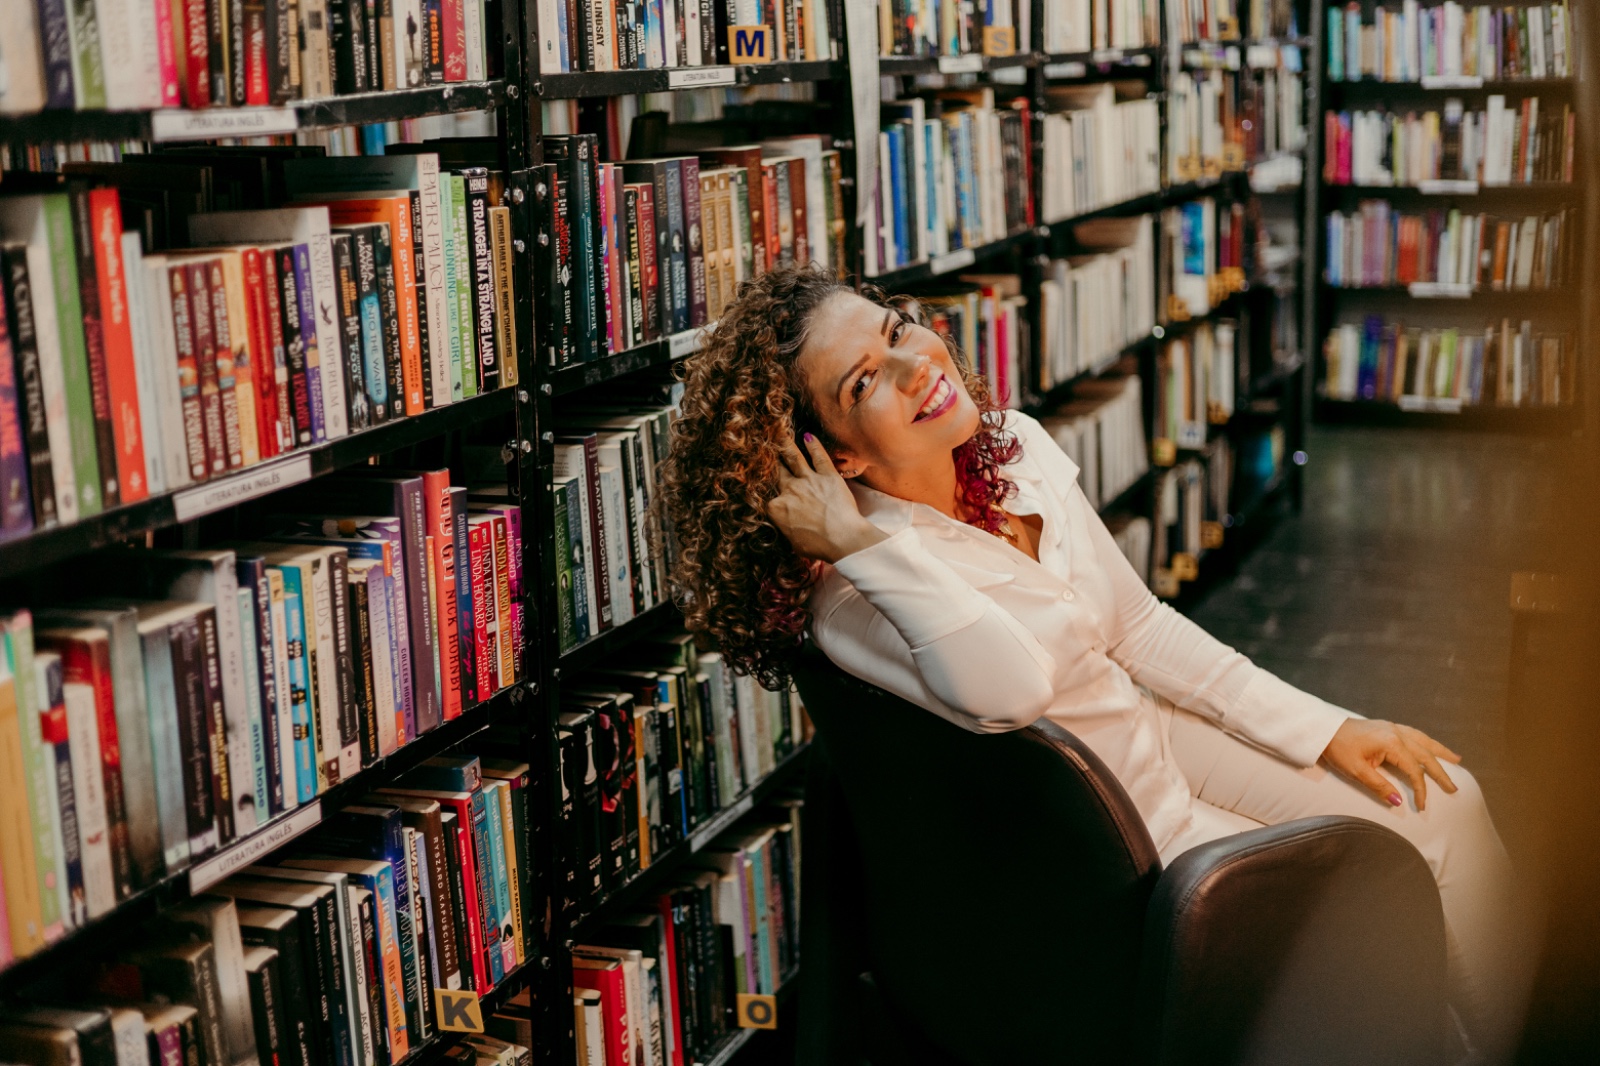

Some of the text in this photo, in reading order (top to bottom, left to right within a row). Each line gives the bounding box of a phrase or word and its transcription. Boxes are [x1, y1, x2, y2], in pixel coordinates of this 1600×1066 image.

[278, 14, 289, 67] ISLAND
[430, 10, 440, 64] reckless
[594, 1, 604, 46] LINDSAY
[736, 30, 764, 57] M
[252, 30, 264, 94] WHISTLER
[352, 33, 362, 87] GRISHAM
[358, 44, 366, 76] JOHN
[236, 114, 264, 127] INGLÊS
[423, 160, 436, 170] the
[423, 172, 443, 295] PAPER PALACE
[458, 206, 469, 289] PEOPLE WE MEET
[630, 227, 638, 259] THE
[318, 233, 332, 290] ROBERT
[357, 235, 369, 292] HAWKINS
[365, 244, 374, 281] PAULA
[386, 265, 394, 287] THE
[397, 203, 416, 352] really good, actually
[445, 239, 456, 299] RUNNING
[472, 198, 494, 366] STRANGER IN A STRANGE LAND
[496, 213, 512, 358] ARTHUR HAILEY THE MONEYCHANGERS
[340, 270, 352, 317] HARRISON
[349, 282, 357, 300] KIM
[387, 290, 395, 316] GIRL
[606, 292, 610, 306] of
[380, 278, 395, 386] PAULA HAWKINS
[390, 319, 398, 335] ON
[451, 325, 458, 333] A
[460, 293, 472, 370] EMILY HENRY
[562, 290, 572, 362] SLEIGHT HAND
[606, 310, 612, 324] Pi
[324, 336, 339, 407] IMPERIUM
[350, 344, 359, 381] POOL
[367, 302, 377, 332] INTO
[373, 358, 382, 396] WATER
[451, 336, 461, 367] GIRL
[394, 362, 402, 395] TRAIN
[203, 471, 281, 506] LITERATURA INGLÊS
[567, 486, 577, 541] MARTIN
[594, 480, 604, 526] SATAPUR
[416, 513, 424, 549] SECRET
[458, 514, 470, 595] CATHERINE RYAN HOWARD
[508, 532, 517, 578] HOWARD
[421, 580, 428, 593] OF
[443, 545, 456, 583] Girl
[495, 538, 508, 612] LINDA HOWARD
[598, 530, 610, 600] MOONSTONE
[314, 580, 330, 626] SEEDS
[334, 570, 346, 653] MAGPIE MURDERS
[391, 540, 406, 642] ALL YOUR PERFECTS
[446, 590, 458, 627] NICK
[472, 550, 485, 629] LINDA HOWARD
[484, 578, 494, 622] HOWARD
[574, 570, 584, 618] SWORDS
[422, 596, 431, 646] BUILDINGS
[516, 604, 526, 654] KISS ME
[448, 633, 462, 692] HORNBY
[502, 630, 513, 682] DREAM MAN
[400, 648, 412, 719] COLLEEN HOOVER
[214, 702, 224, 750] ELEPHANT
[245, 621, 268, 808] expectation anna hope
[504, 790, 514, 831] HEAVEN
[218, 822, 292, 872] LITERATURA INGLÊS
[490, 794, 506, 880] Sophie Kinsella
[382, 896, 394, 955] VENDETTA
[433, 836, 452, 972] RYSZARD KAPUŚCIŃSKI
[514, 892, 522, 932] KAWAKAMI
[326, 899, 341, 990] Fifty Shades of Grey
[352, 916, 364, 986] FALSE BINGO
[394, 858, 418, 1002] THESE BROKEN STARS
[262, 968, 278, 1048] PETER JAMES
[387, 959, 402, 1047] IRIS JOHANSEN
[441, 996, 478, 1029] K
[747, 1000, 772, 1024] O
[360, 1011, 370, 1058] JAC JEMC
